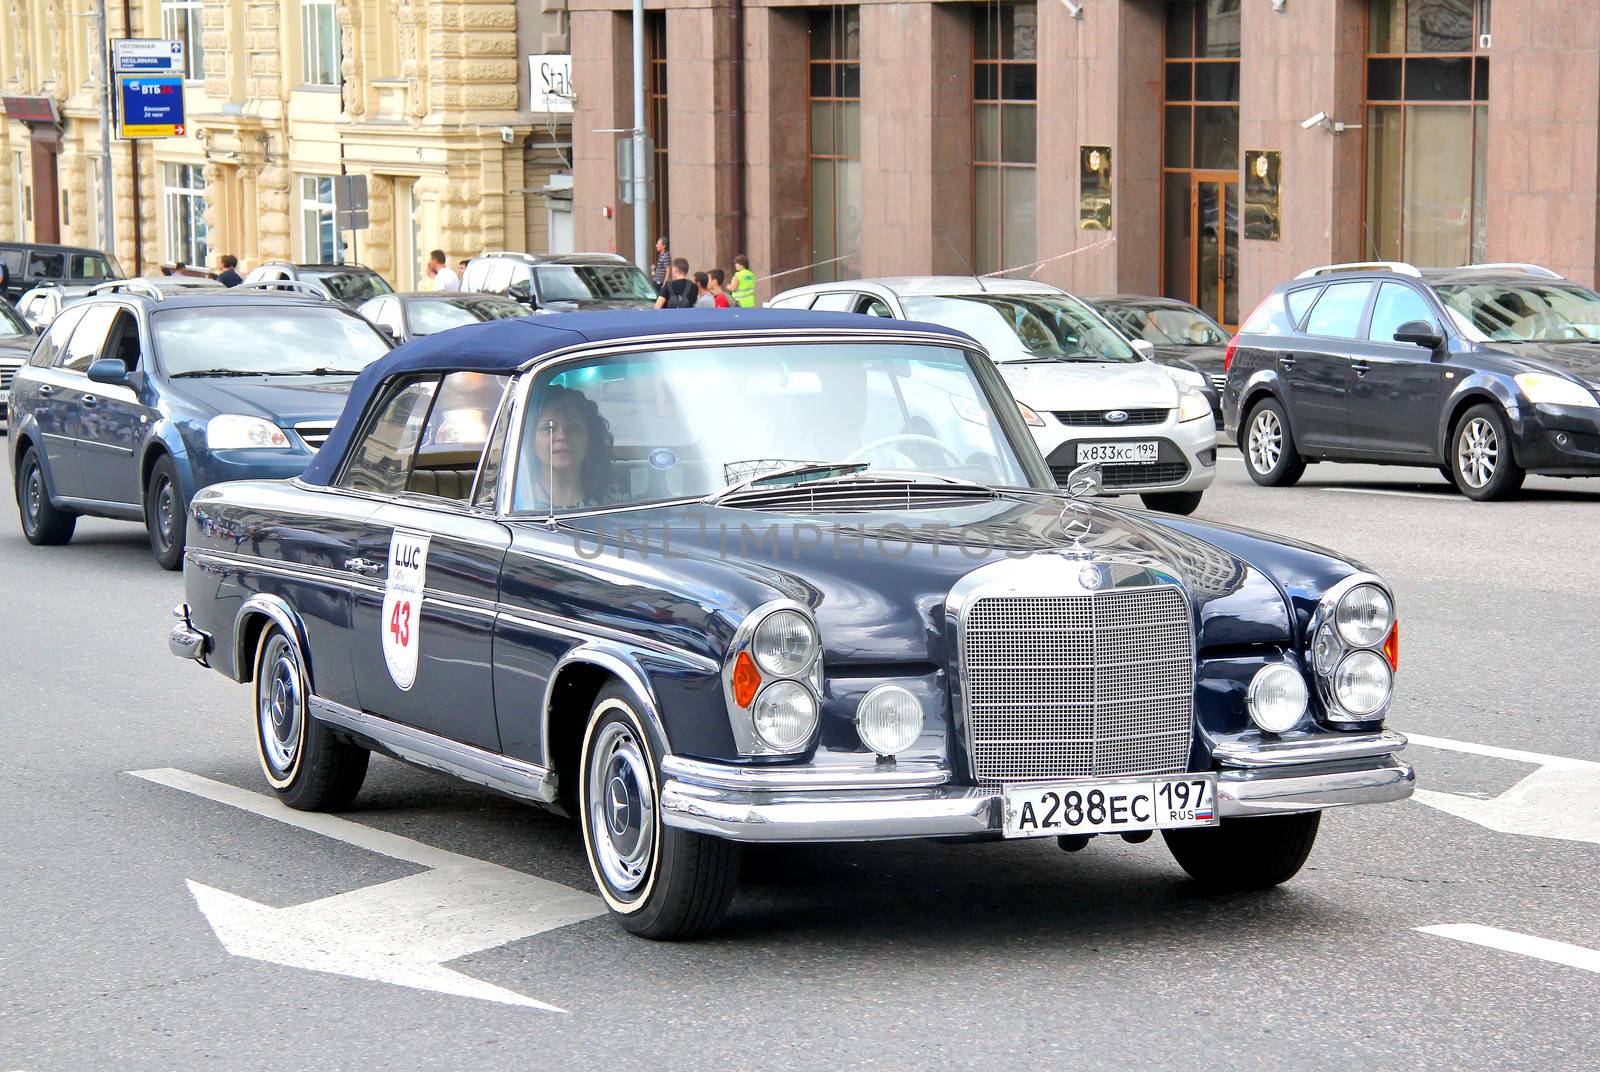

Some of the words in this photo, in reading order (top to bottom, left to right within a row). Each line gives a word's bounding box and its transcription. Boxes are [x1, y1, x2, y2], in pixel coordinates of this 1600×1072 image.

[1136, 443, 1155, 455] 199
[390, 600, 410, 647] 43
[1159, 780, 1206, 810] 197
[1170, 810, 1194, 821] RUS
